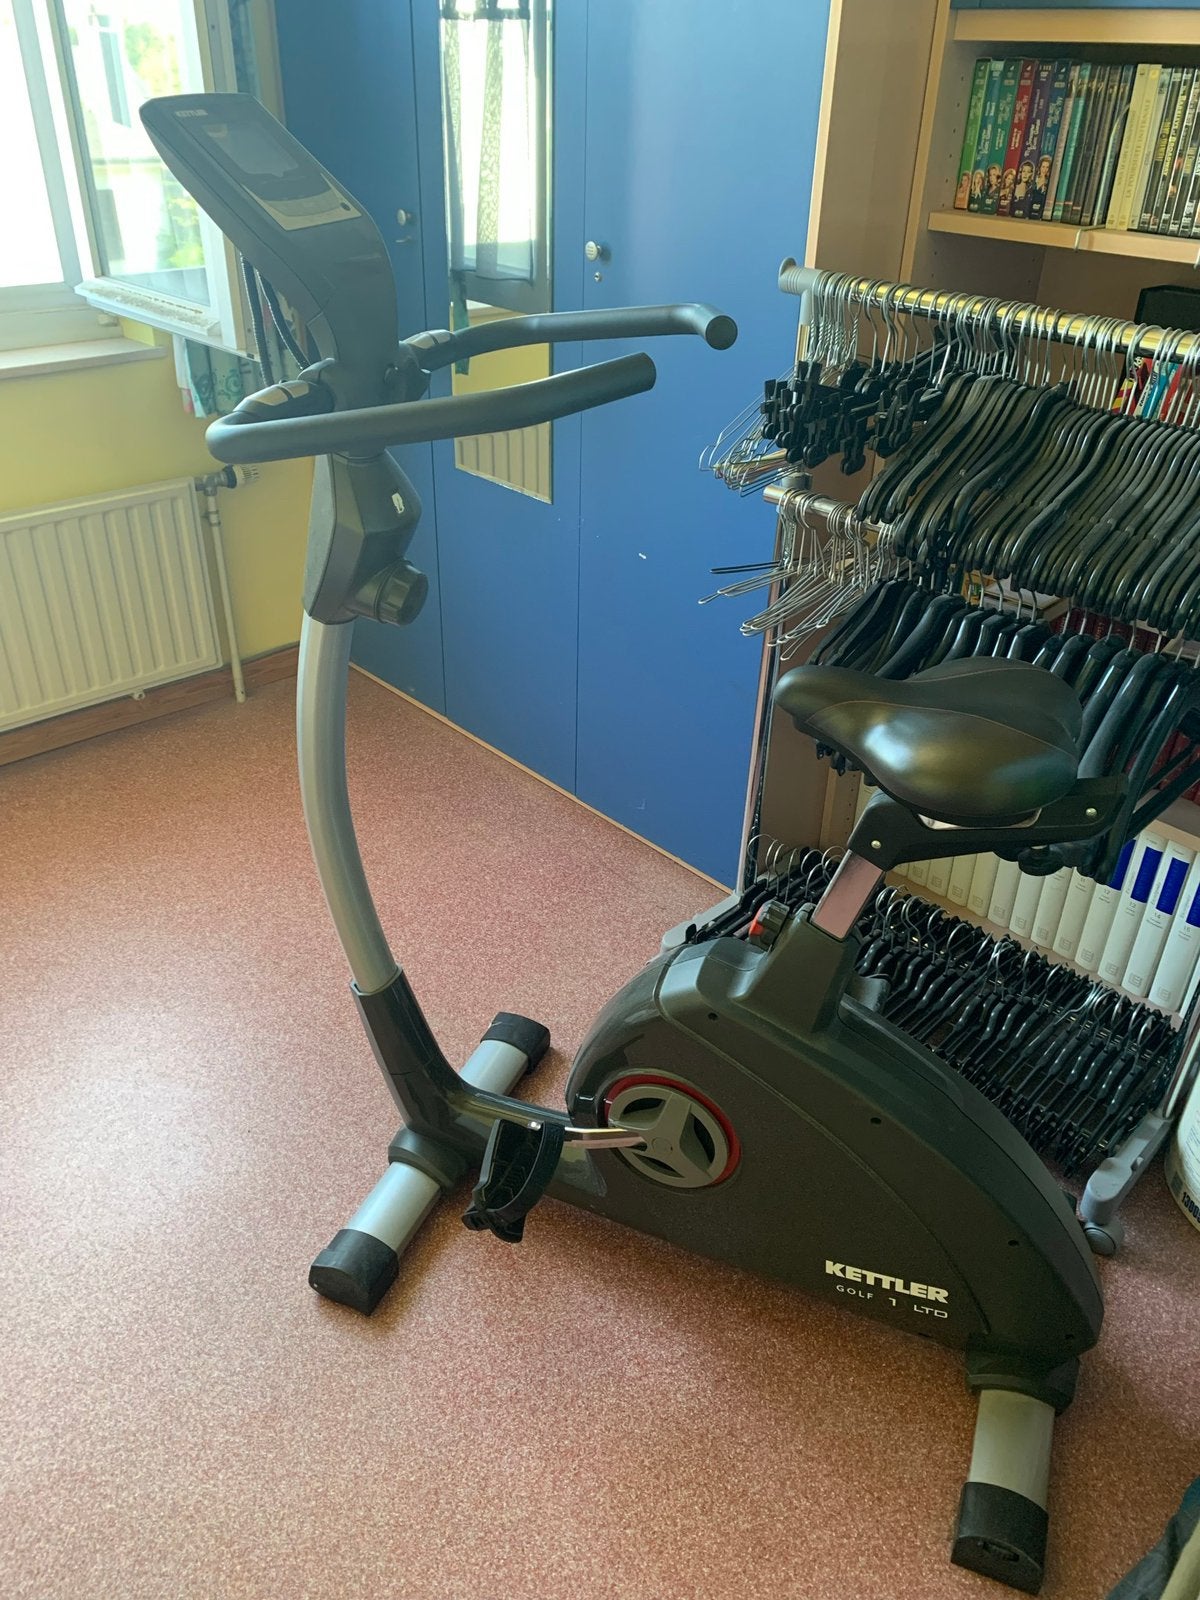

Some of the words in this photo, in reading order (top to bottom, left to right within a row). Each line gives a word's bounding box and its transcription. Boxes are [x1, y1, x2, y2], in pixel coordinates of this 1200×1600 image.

[1161, 135, 1176, 176] BROADWAY
[825, 1259, 949, 1304] KETTLER
[836, 1284, 874, 1300] GOLF
[913, 1304, 948, 1319] LTD
